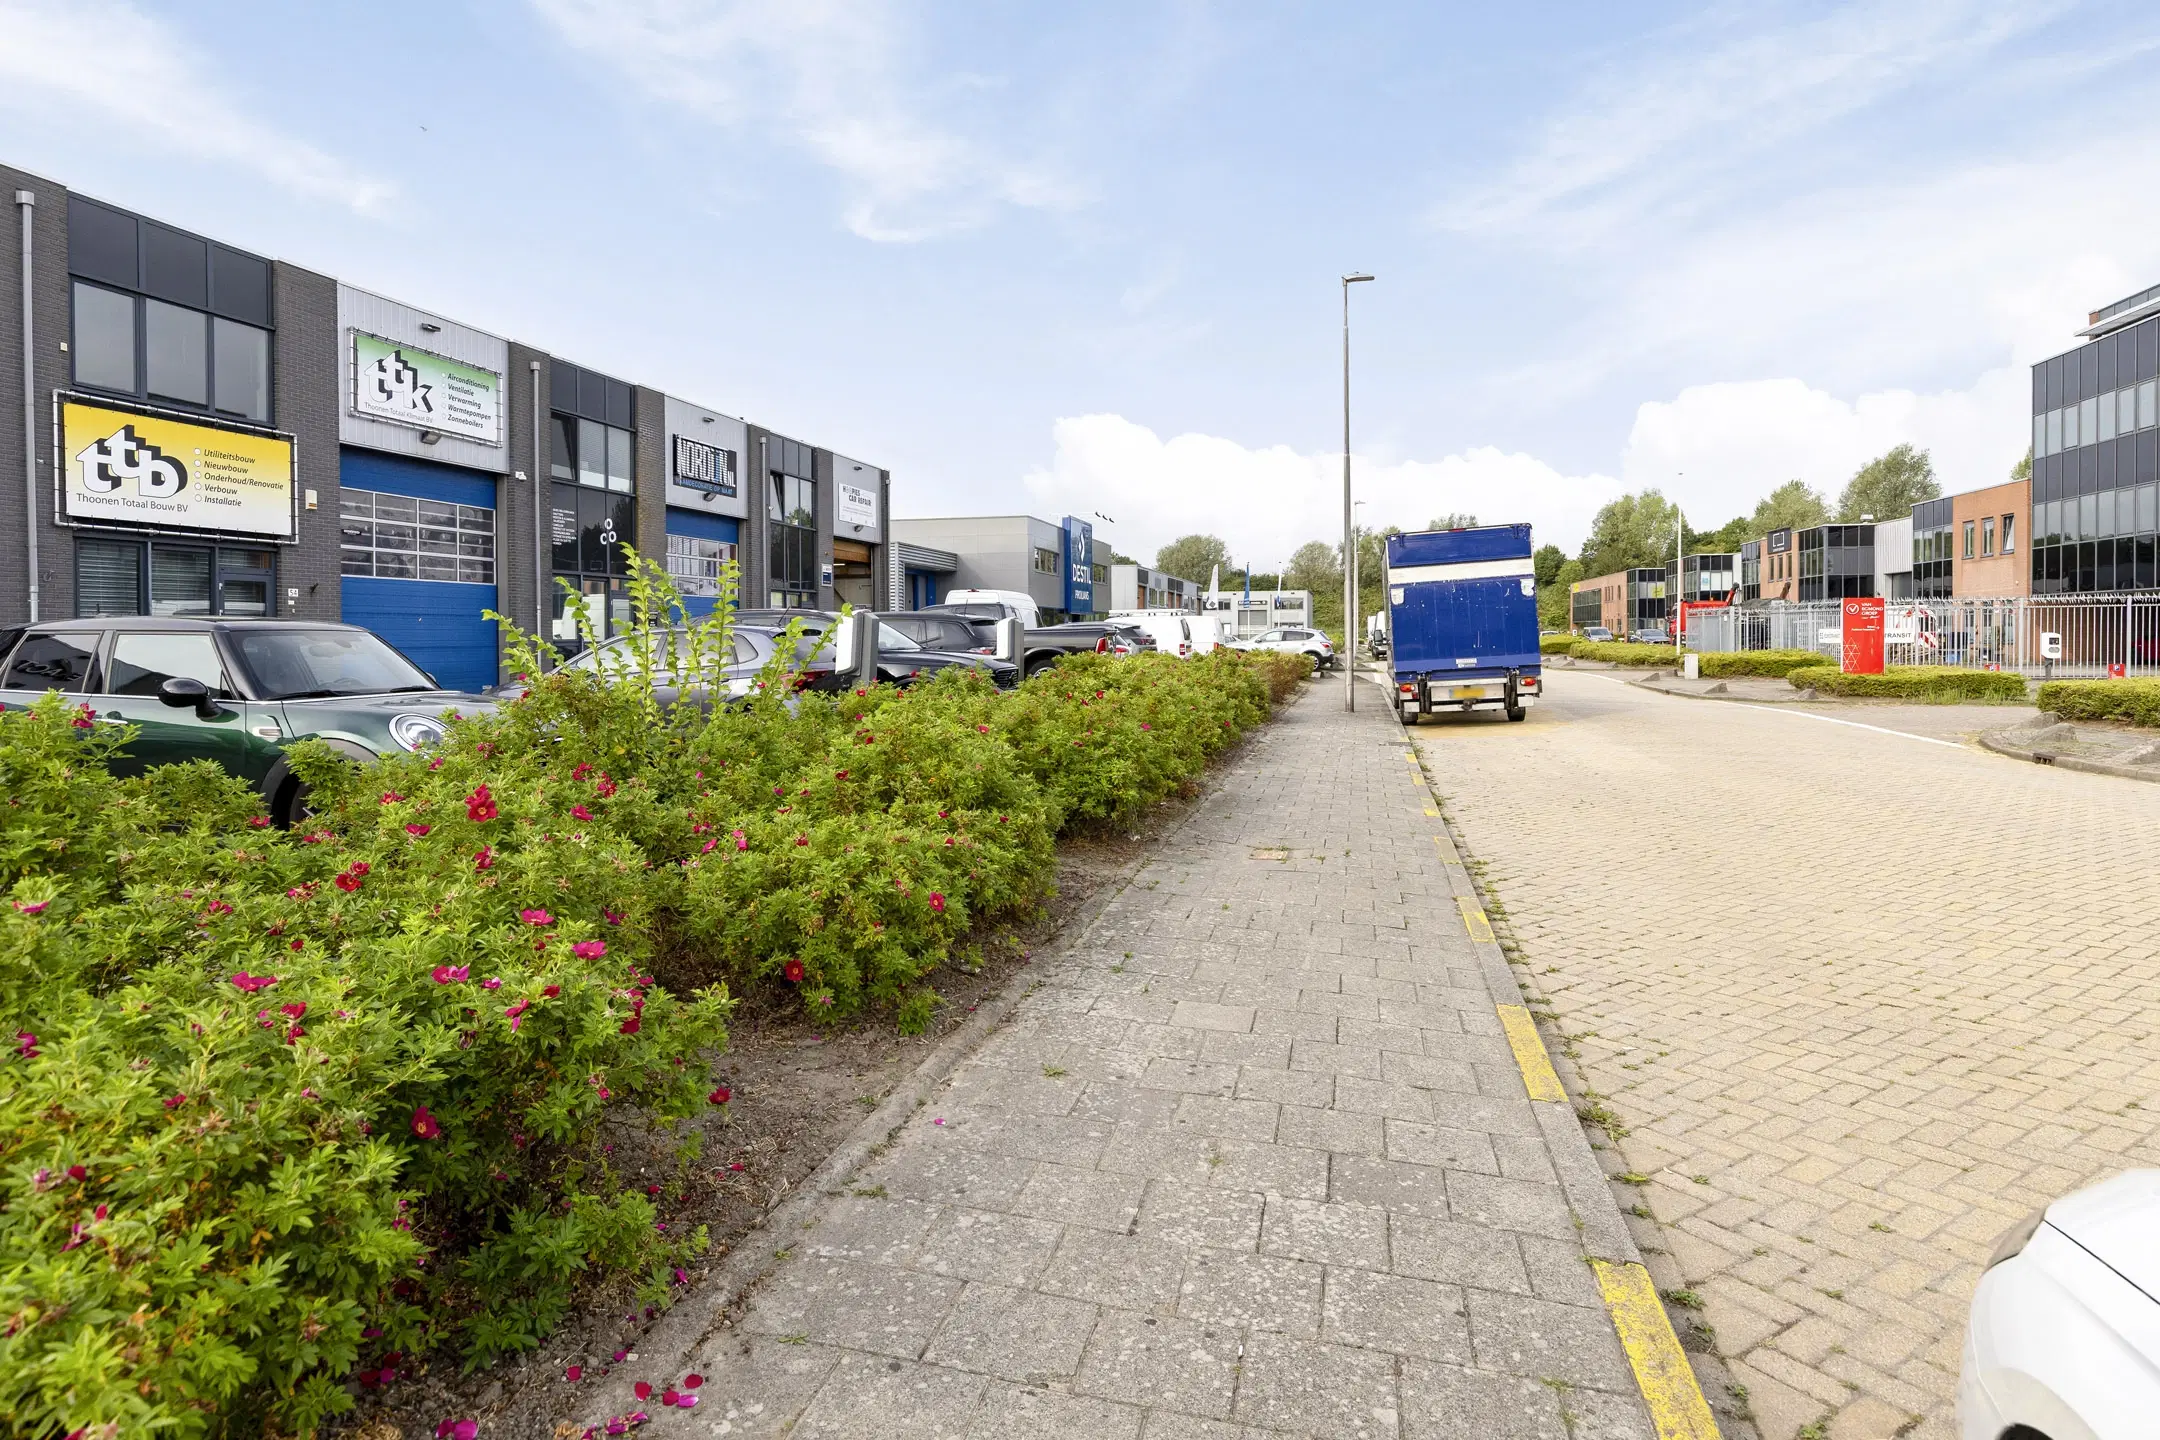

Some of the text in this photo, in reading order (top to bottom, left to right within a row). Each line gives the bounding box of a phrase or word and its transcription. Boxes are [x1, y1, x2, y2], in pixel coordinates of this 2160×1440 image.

[447, 373, 490, 391] Airconditioning
[447, 383, 474, 397] Ventilatie
[447, 393, 481, 409] Verwarming
[364, 402, 388, 412] Thoonen
[390, 407, 405, 416] Totaal
[448, 404, 491, 420] Warmtepompen
[447, 414, 484, 429] Zonneboilers
[203, 448, 256, 464] Utiliteitsbouw
[203, 460, 249, 474] Nieuwbouw
[204, 472, 284, 490] Onderhoud/Renovatie
[204, 483, 238, 495] Verbouw
[76, 492, 188, 512] Thoonen Totaal Bouw BV
[204, 495, 242, 507] Installatie
[848, 494, 857, 502] CAR
[1072, 564, 1092, 584] DESTIL
